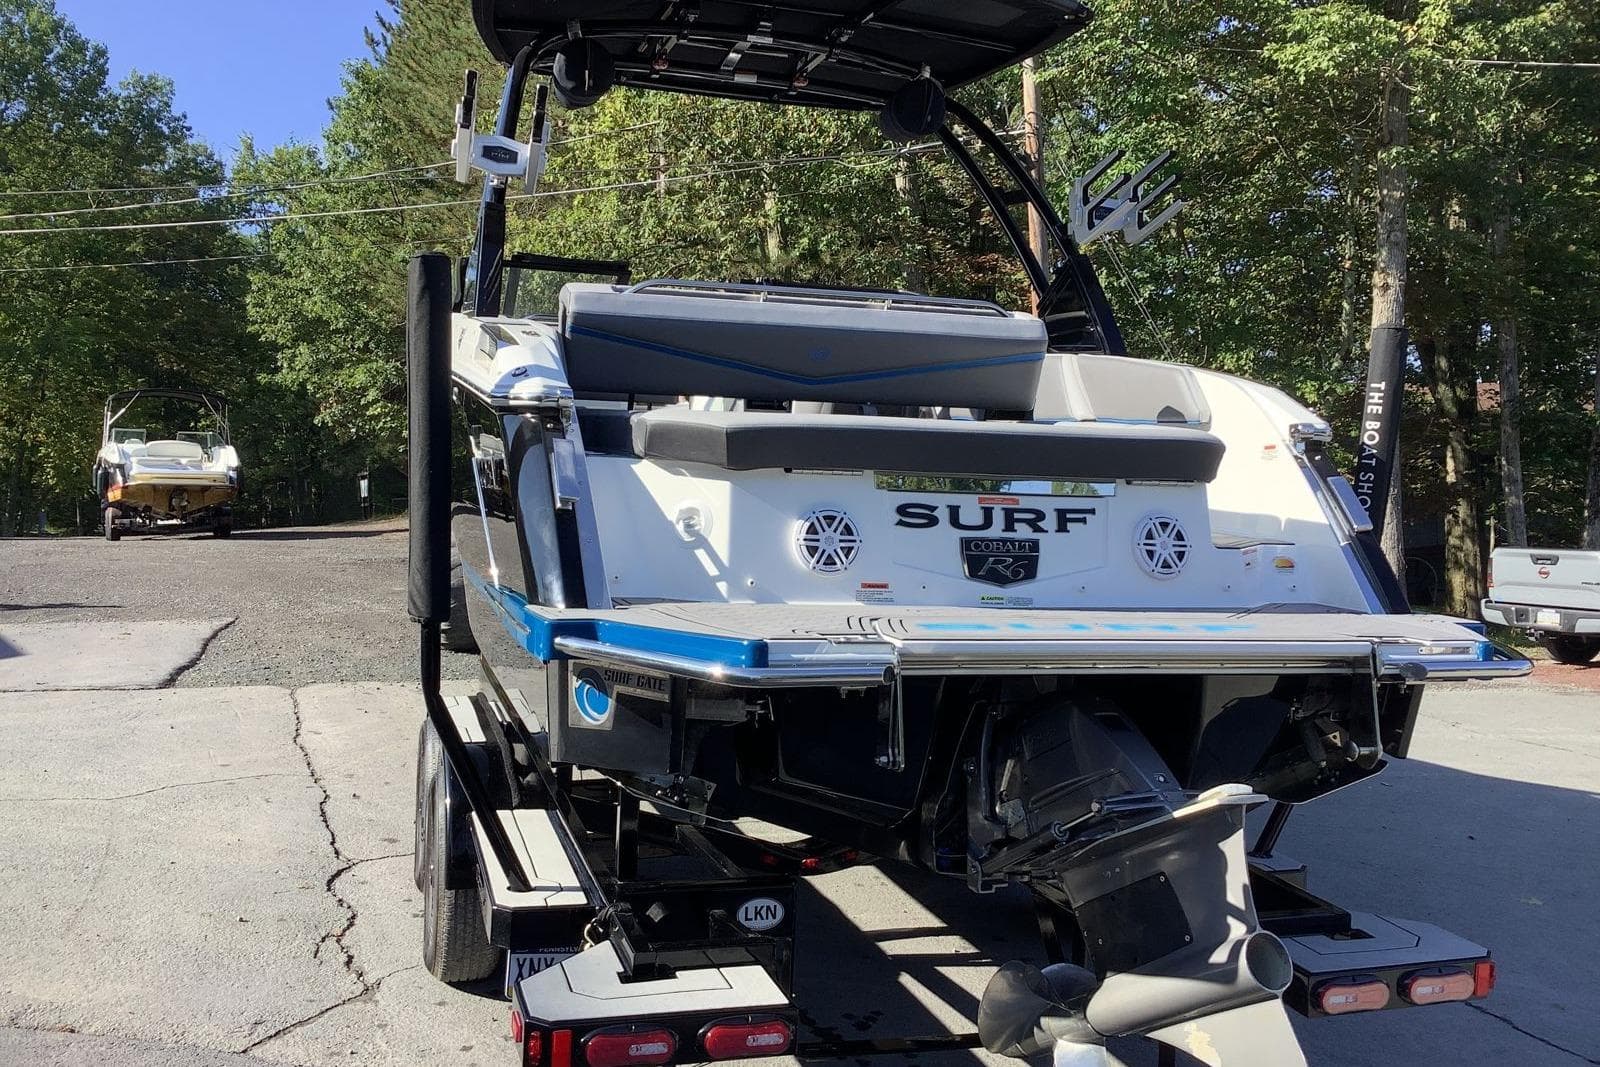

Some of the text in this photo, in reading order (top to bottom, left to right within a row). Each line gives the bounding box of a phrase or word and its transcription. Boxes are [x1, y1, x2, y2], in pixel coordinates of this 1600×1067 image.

[1357, 382, 1385, 512] THE BOAT SHO
[895, 503, 1096, 533] SURF
[970, 540, 1033, 553] COBALT
[977, 556, 1029, 580] R6
[605, 670, 666, 691] SURF GATE
[744, 904, 777, 922] LKN
